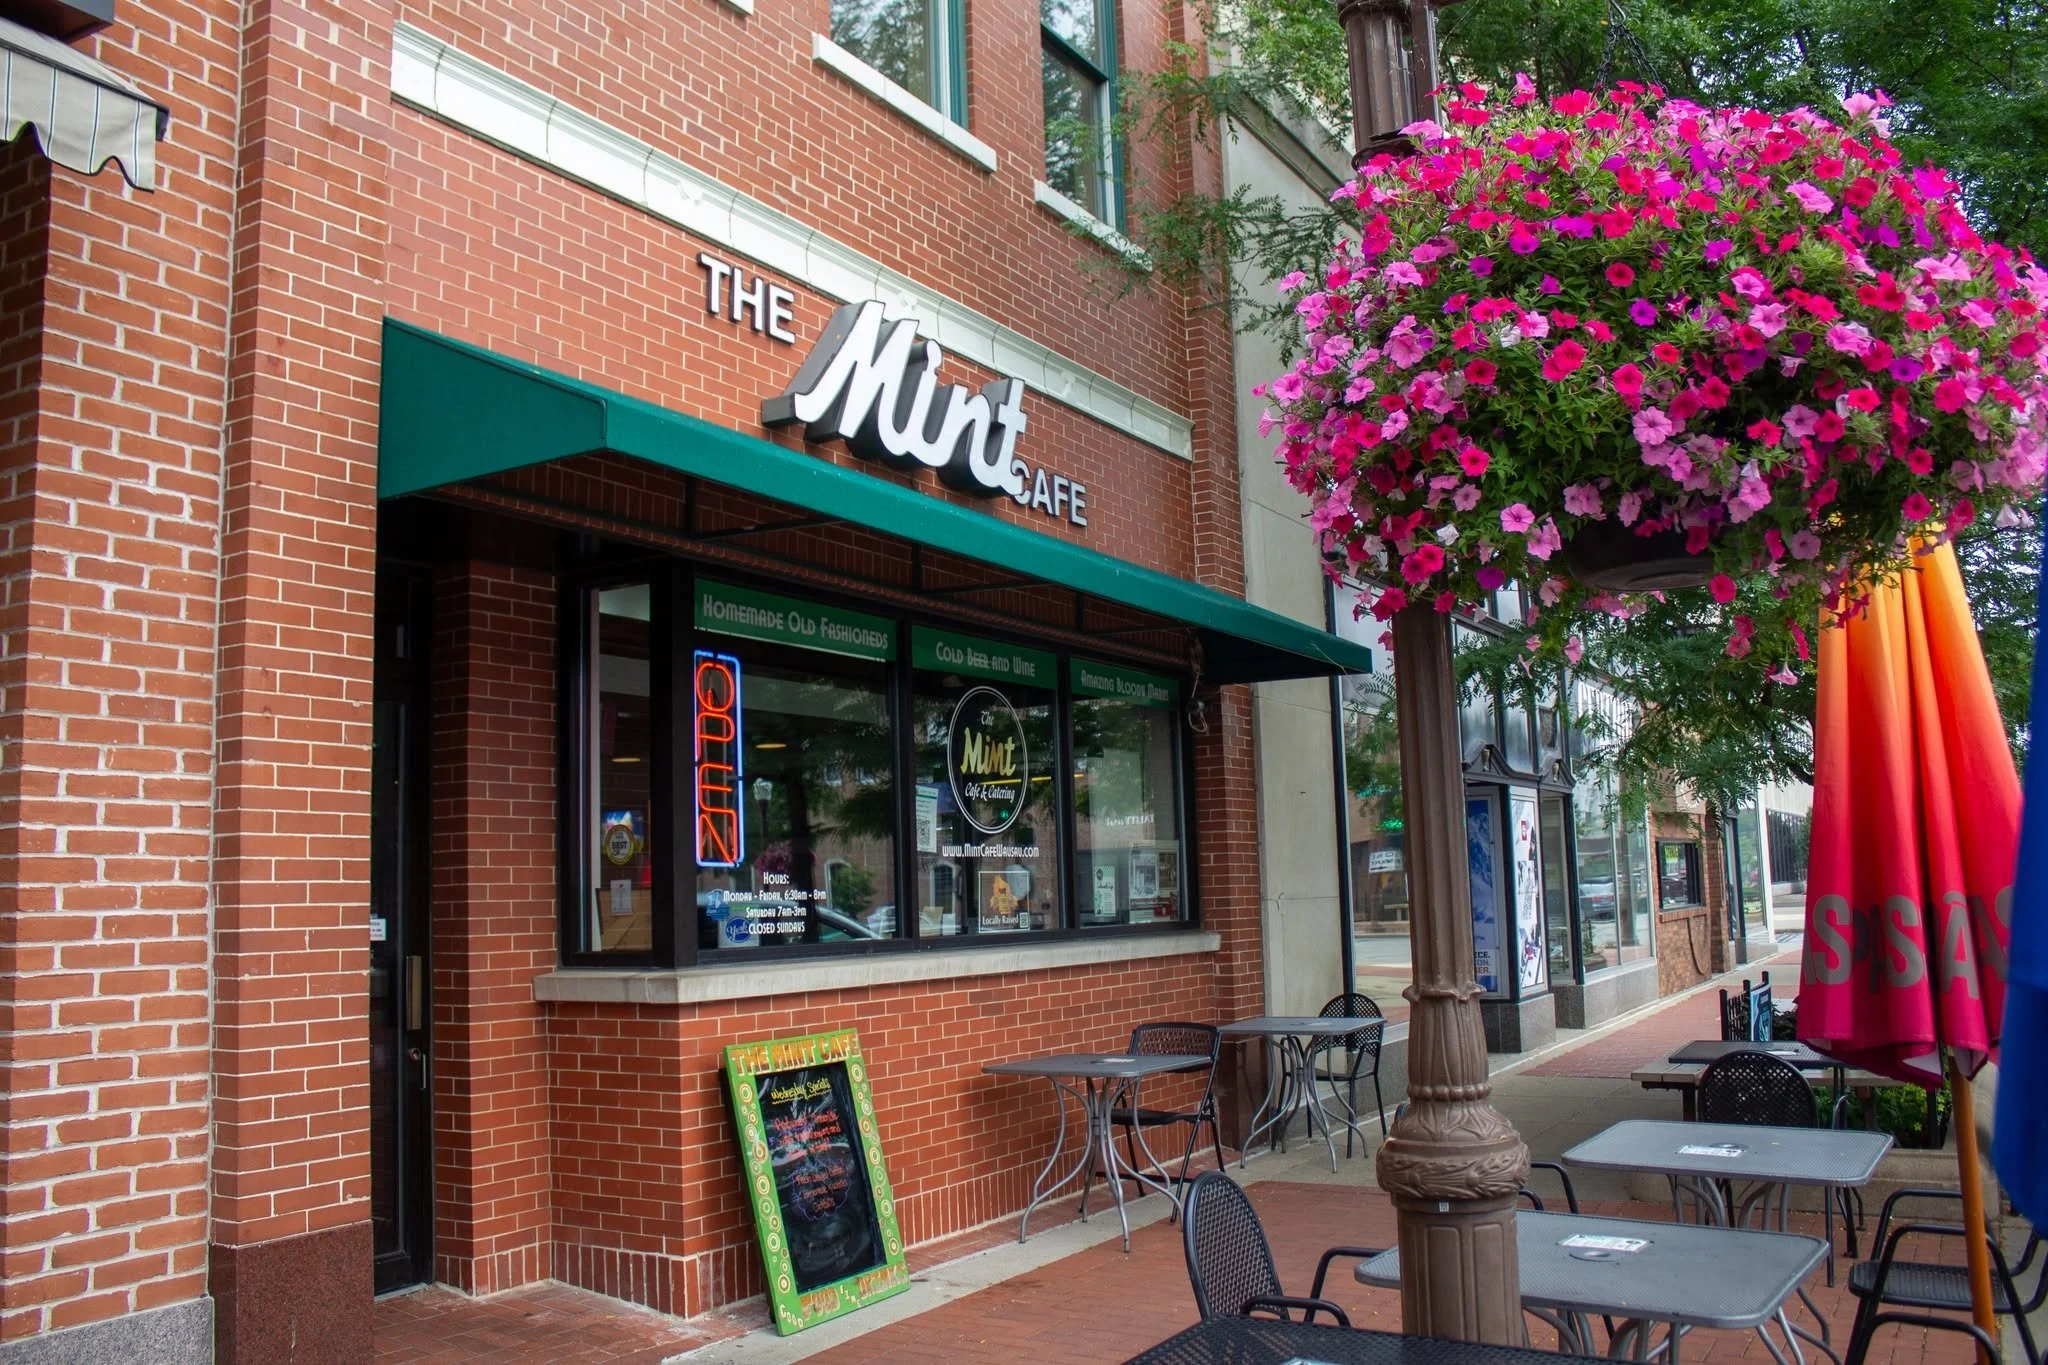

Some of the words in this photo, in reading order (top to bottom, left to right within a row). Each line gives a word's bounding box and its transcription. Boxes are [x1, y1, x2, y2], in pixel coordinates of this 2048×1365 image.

[698, 251, 796, 345] THE
[794, 299, 1027, 497] Mint
[1012, 459, 1088, 527] CAFE
[703, 593, 784, 630] HOMEMADE
[788, 611, 816, 636] OLD
[820, 617, 889, 649] FASHIONEDS
[935, 641, 964, 664] COLD
[967, 647, 990, 669] BEER
[991, 655, 1010, 672] AND
[1012, 656, 1035, 677] WINE
[1081, 669, 1114, 692] AMAZING
[981, 710, 994, 726] The
[696, 662, 738, 864] OPEN
[960, 727, 1016, 776] Mint
[964, 782, 981, 800] Cafe
[980, 784, 988, 801] &
[987, 784, 1015, 803] Catering
[763, 872, 790, 885] HOURS:
[723, 890, 752, 902] MONDAY
[746, 907, 776, 918] SATURDAY
[982, 915, 1001, 926] Locally
[748, 923, 775, 934] CLOSED
[777, 922, 805, 933] SUNDAYS
[730, 1045, 772, 1077] THE
[771, 1039, 817, 1072] MINT
[818, 1033, 861, 1063] CAFE
[780, 1304, 804, 1328] GOOD
